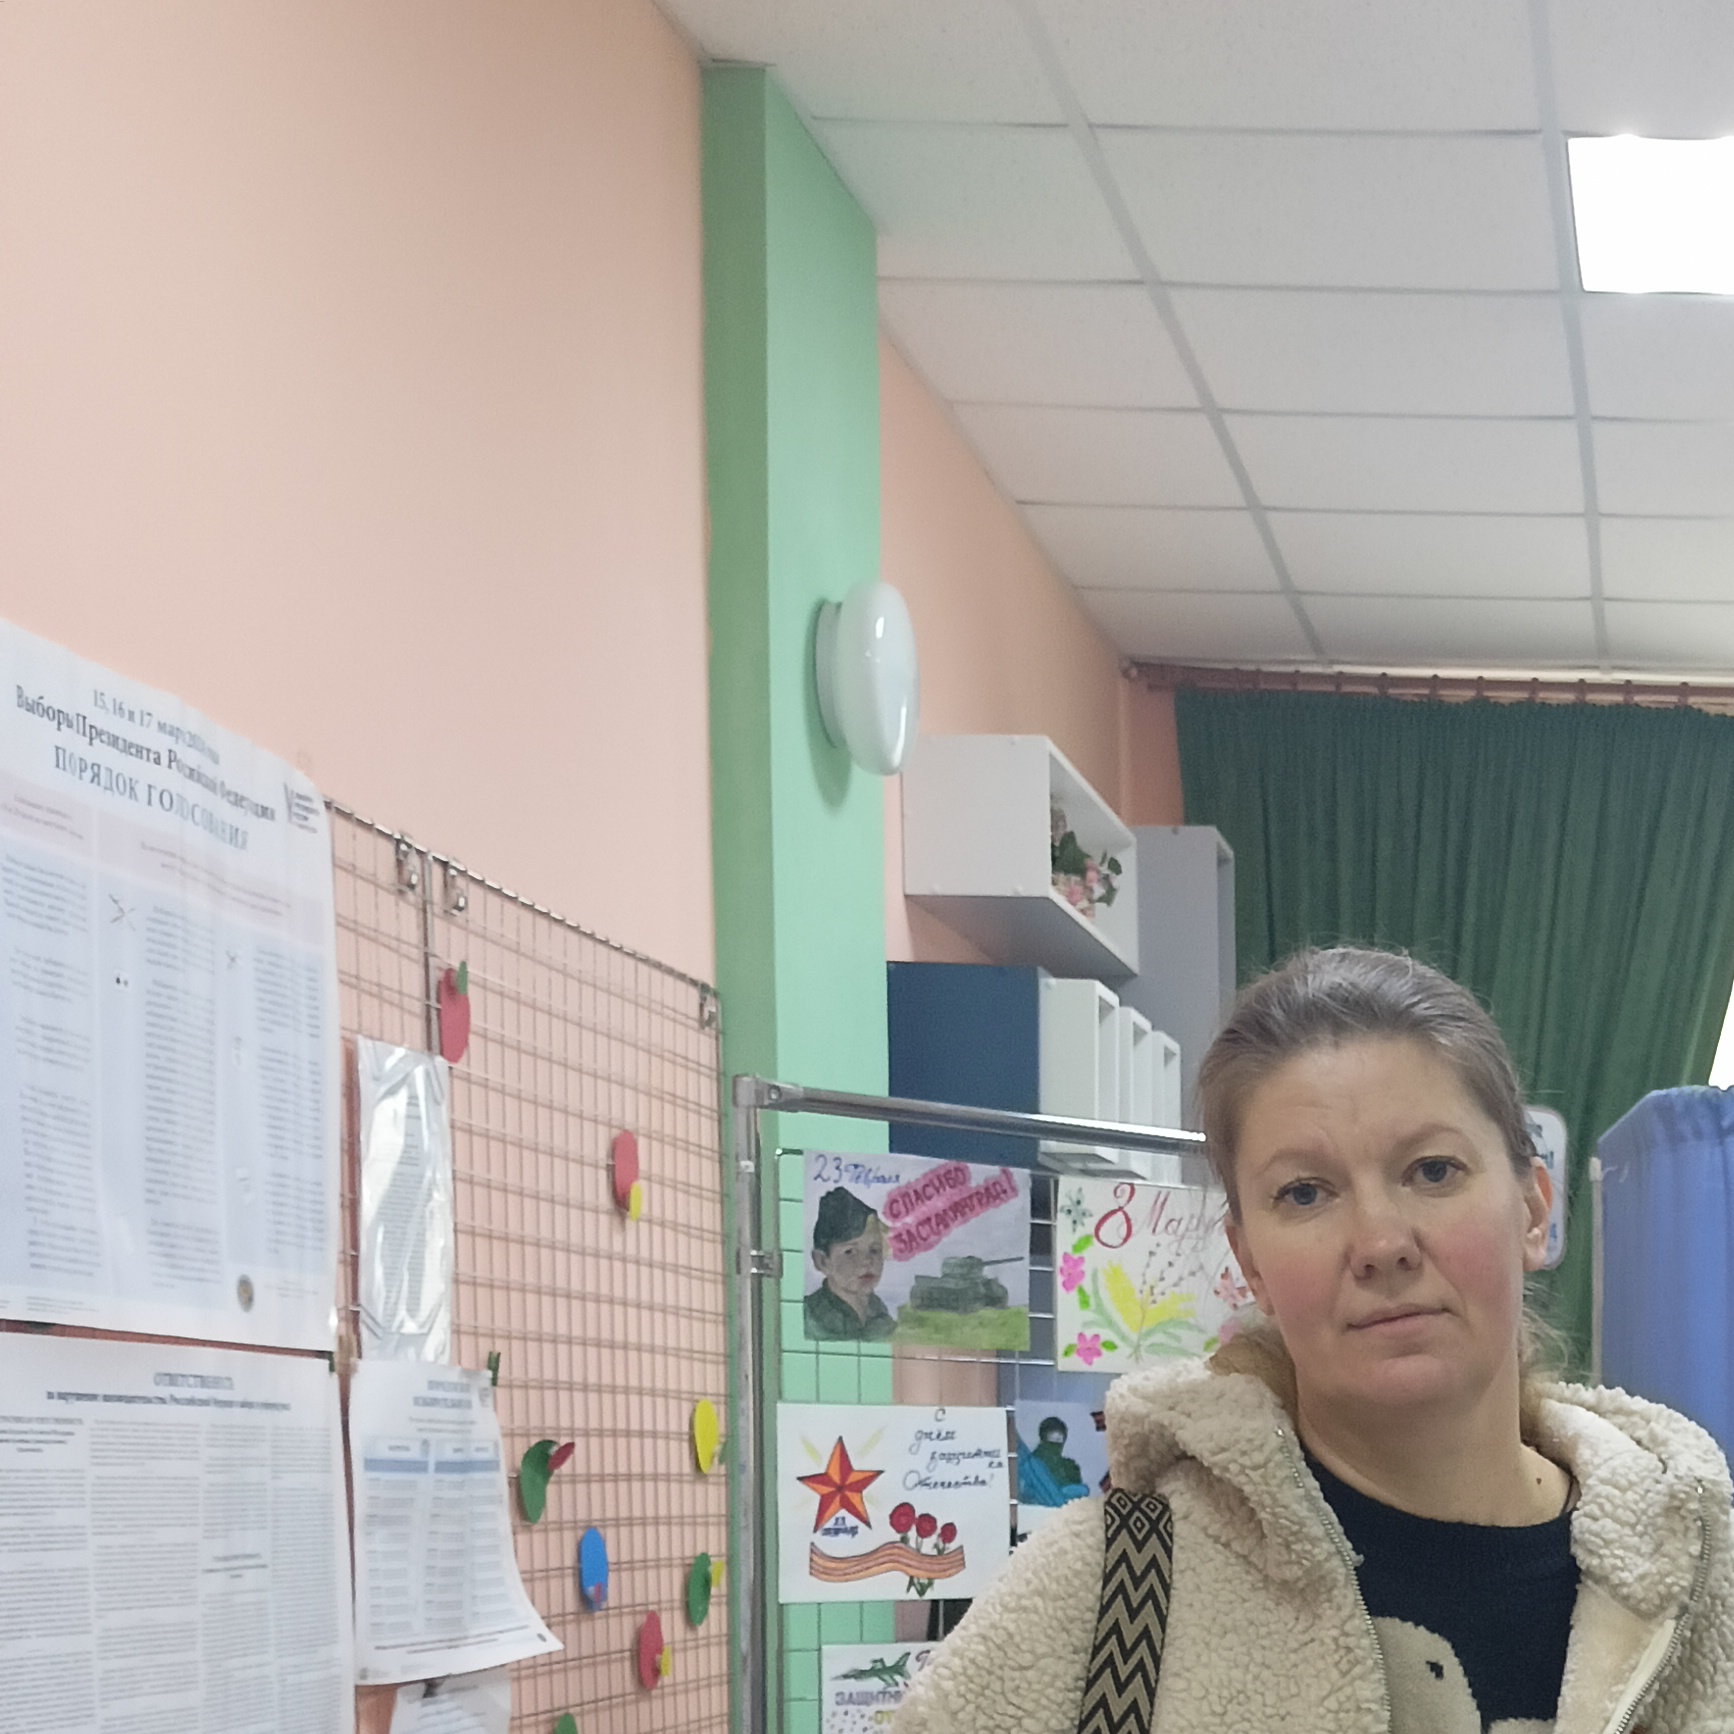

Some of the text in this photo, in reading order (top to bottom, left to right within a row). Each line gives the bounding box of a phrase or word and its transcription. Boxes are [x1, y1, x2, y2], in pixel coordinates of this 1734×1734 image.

[16, 684, 74, 732] Выборы
[75, 712, 162, 767] Президента
[93, 689, 109, 711] 15,
[112, 698, 126, 719] 16
[139, 709, 153, 729] 17
[54, 744, 139, 803] ПОРЯДОК
[813, 1153, 842, 1184] 23
[888, 1165, 968, 1219] СПАСИБО
[1094, 1181, 1135, 1249] 8
